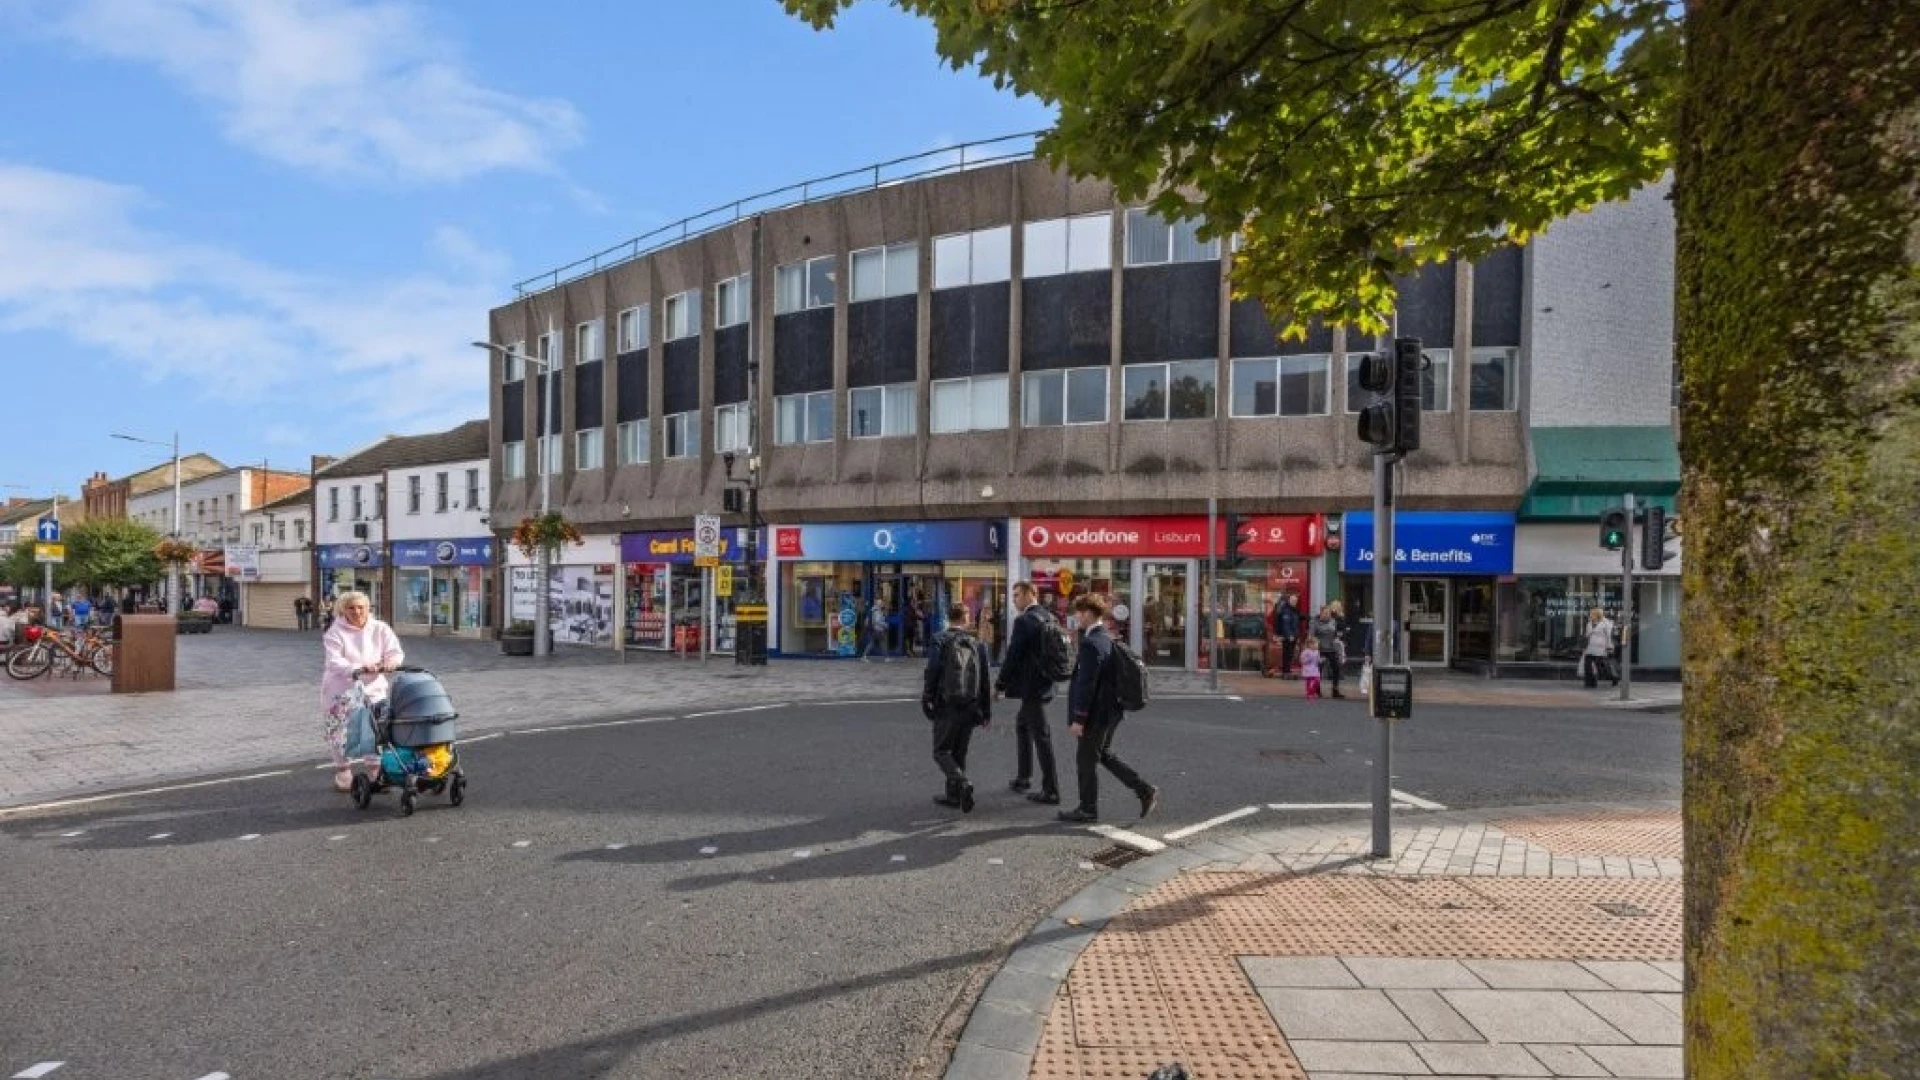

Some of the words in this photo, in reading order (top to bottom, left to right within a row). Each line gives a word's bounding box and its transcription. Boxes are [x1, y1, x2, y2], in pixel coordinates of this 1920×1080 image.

[1055, 528, 1139, 544] vodafone
[1154, 532, 1201, 543] Lisburn
[650, 539, 678, 554] Card
[1394, 549, 1407, 562] &
[1411, 549, 1473, 562] Benefits
